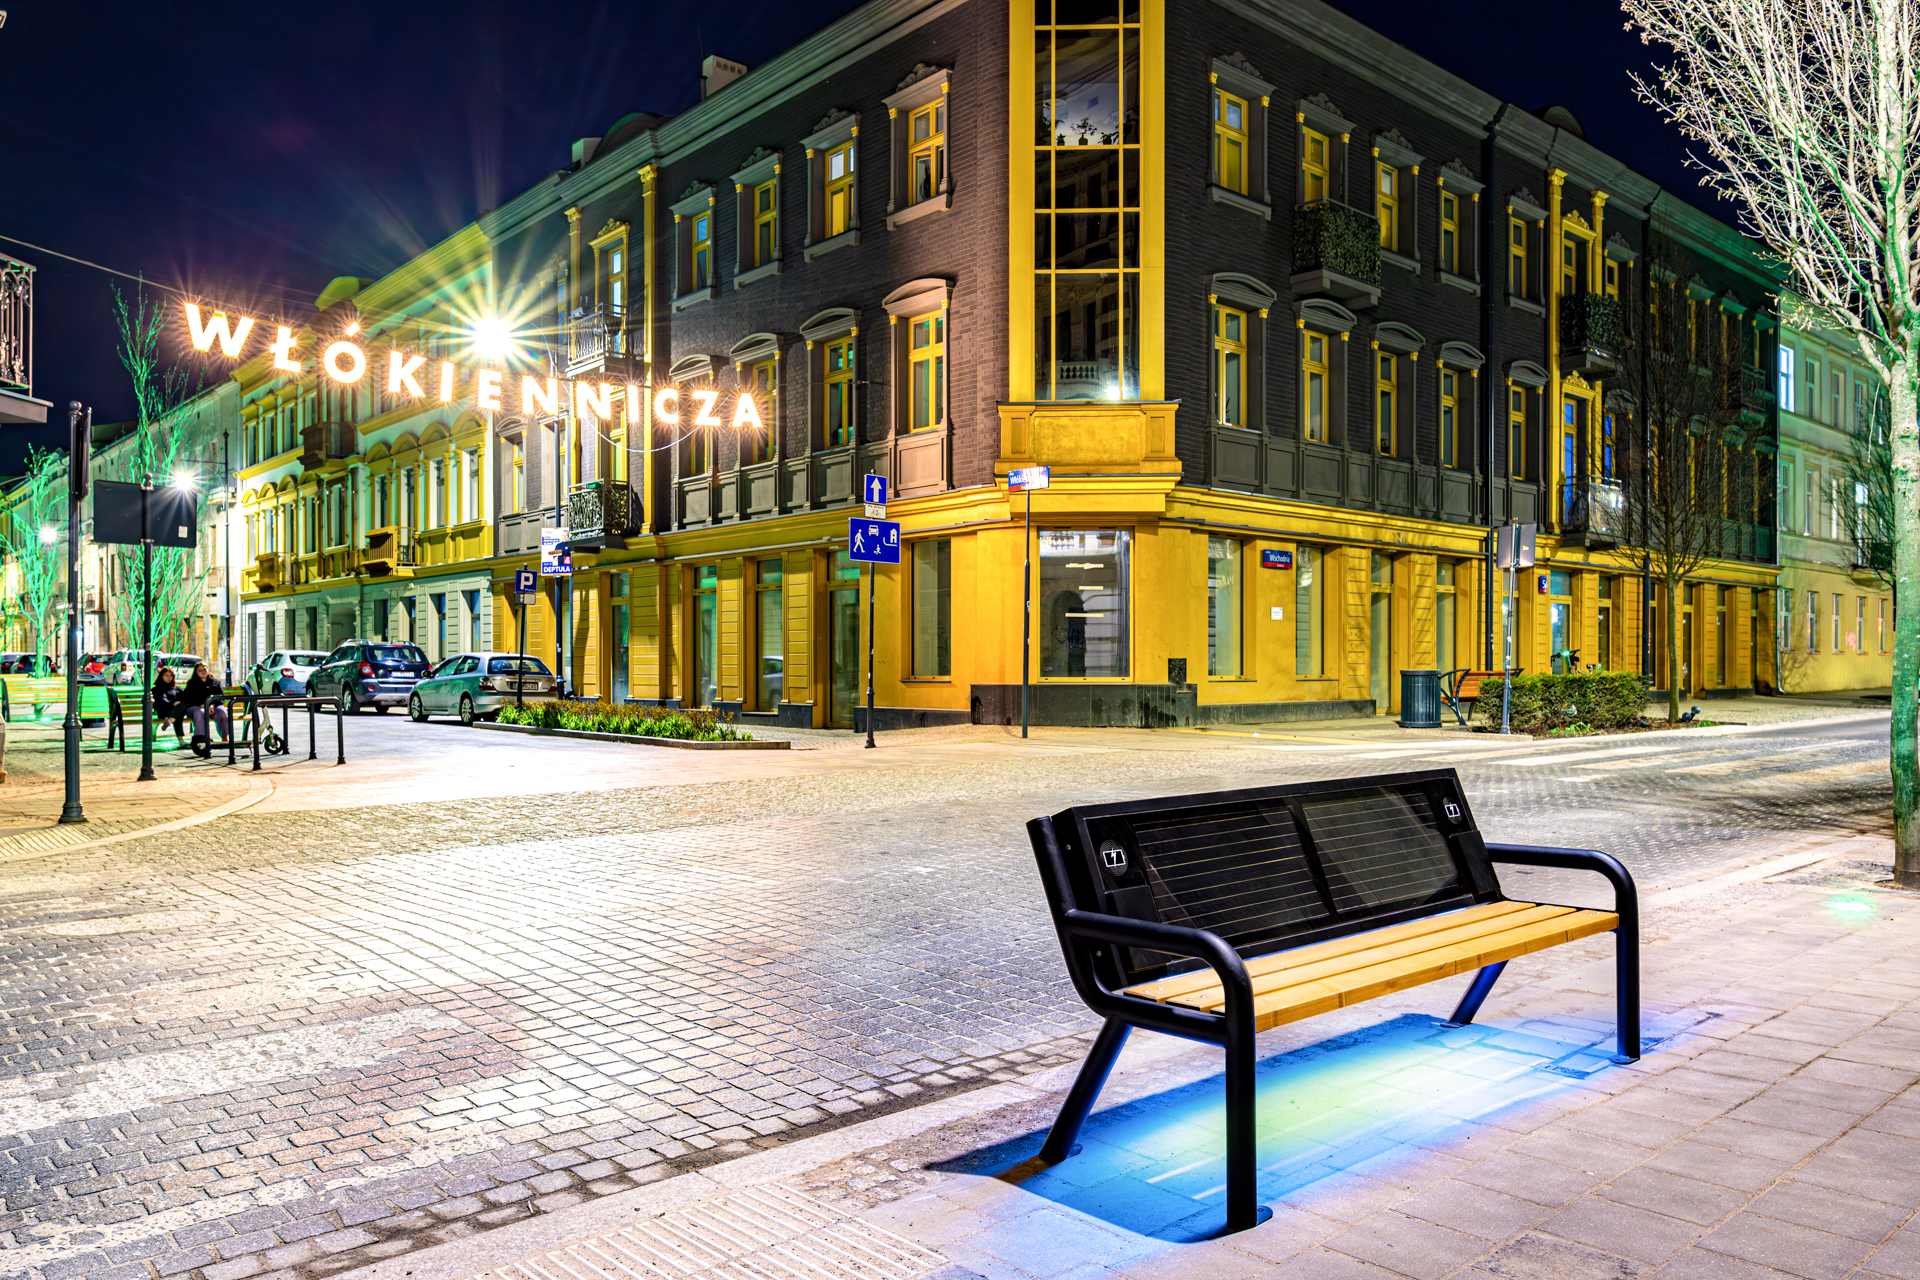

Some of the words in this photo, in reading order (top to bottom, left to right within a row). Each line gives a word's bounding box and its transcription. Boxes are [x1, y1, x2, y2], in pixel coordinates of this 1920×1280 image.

[183, 302, 764, 428] WŁÓKIENNICZA
[564, 556, 570, 565] 4
[543, 565, 571, 573] DEPTUŁA
[520, 572, 533, 590] P
